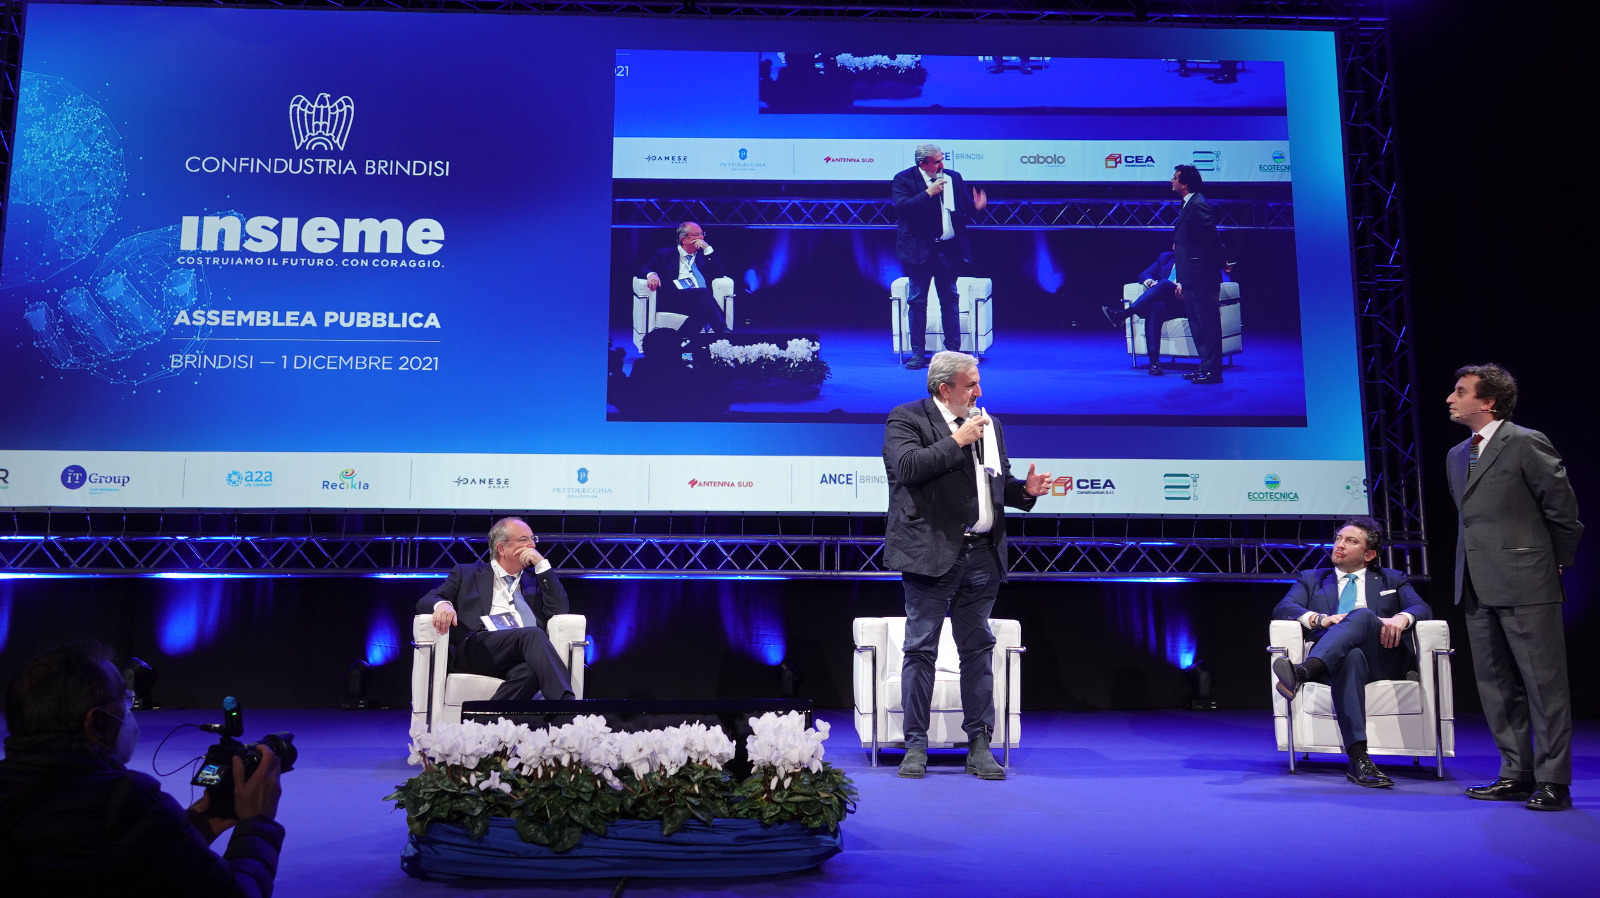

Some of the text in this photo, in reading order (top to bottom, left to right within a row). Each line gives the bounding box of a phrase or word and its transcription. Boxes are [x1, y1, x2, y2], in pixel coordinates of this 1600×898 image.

[1020, 153, 1066, 165] cabolo
[1124, 155, 1156, 164] CEA
[184, 156, 450, 177] CONFINDUSTRIA BRINDISI
[177, 256, 445, 268] COSTRUIAMO IL FUTURO. CON CORAGGIO.
[173, 309, 442, 329] ASSEMBLEA PUBBLICA
[170, 354, 254, 369] BRINDISI
[281, 354, 287, 370] 1
[293, 354, 393, 370] DICEMBRE
[398, 356, 439, 371] 2021
[88, 472, 131, 487] Group
[244, 470, 273, 483] a2a
[462, 477, 510, 486] DANESE
[819, 473, 854, 485] ANCE
[321, 480, 370, 490] Recikla
[698, 480, 754, 488] ANTENNA SUD
[1076, 478, 1116, 490] CEA
[1247, 491, 1300, 500] ECOTECNICA
